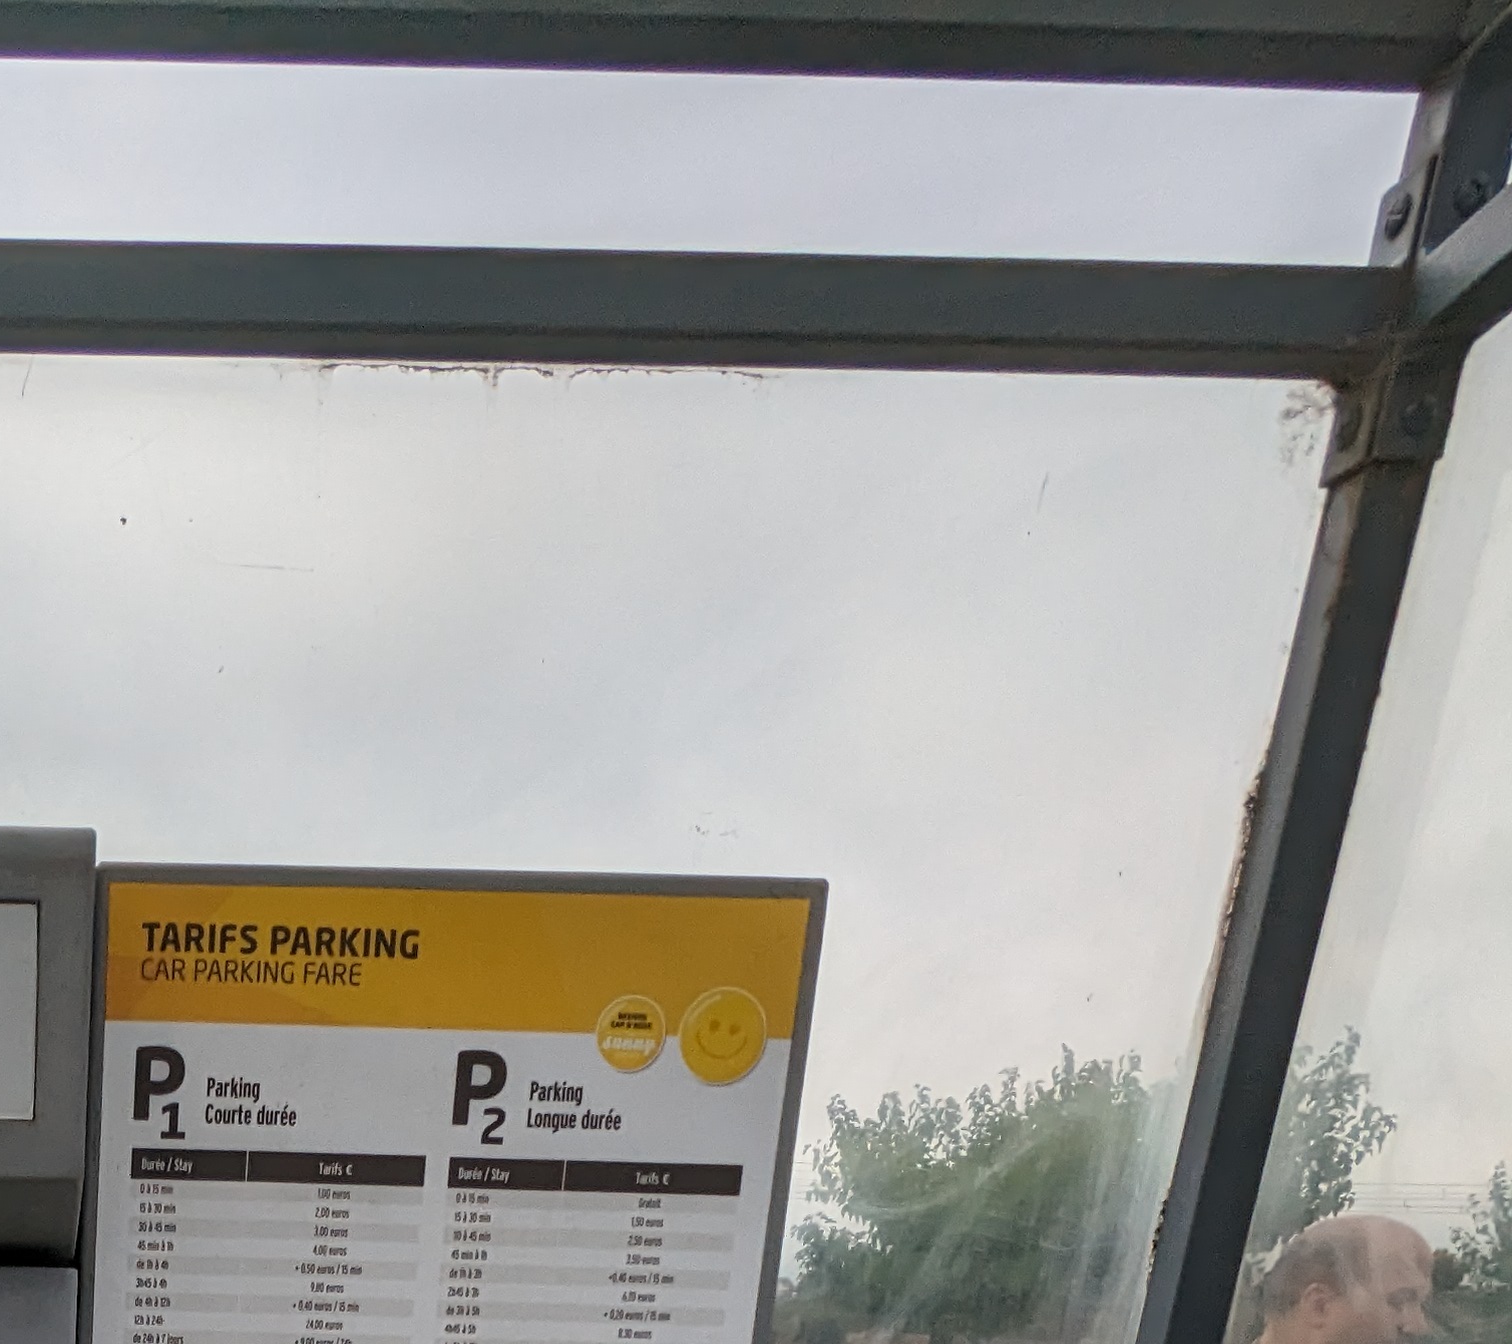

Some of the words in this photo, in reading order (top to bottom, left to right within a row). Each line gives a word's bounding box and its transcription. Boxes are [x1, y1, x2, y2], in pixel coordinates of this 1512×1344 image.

[142, 922, 258, 954] TARIFS
[270, 926, 420, 959] PARKING
[141, 957, 186, 982] CAR
[194, 959, 295, 985] PARKING
[303, 962, 363, 986] FARE
[207, 1077, 261, 1103] Parking
[530, 1081, 583, 1106] Parking
[205, 1104, 252, 1125] Courte
[257, 1103, 297, 1127] durée
[527, 1108, 577, 1134] Longue
[582, 1108, 622, 1131] durée
[141, 1157, 166, 1171] Durée
[174, 1158, 194, 1174] Stay
[319, 1162, 343, 1176] Tarifs
[458, 1167, 483, 1180] Durée
[491, 1168, 510, 1184] Stay
